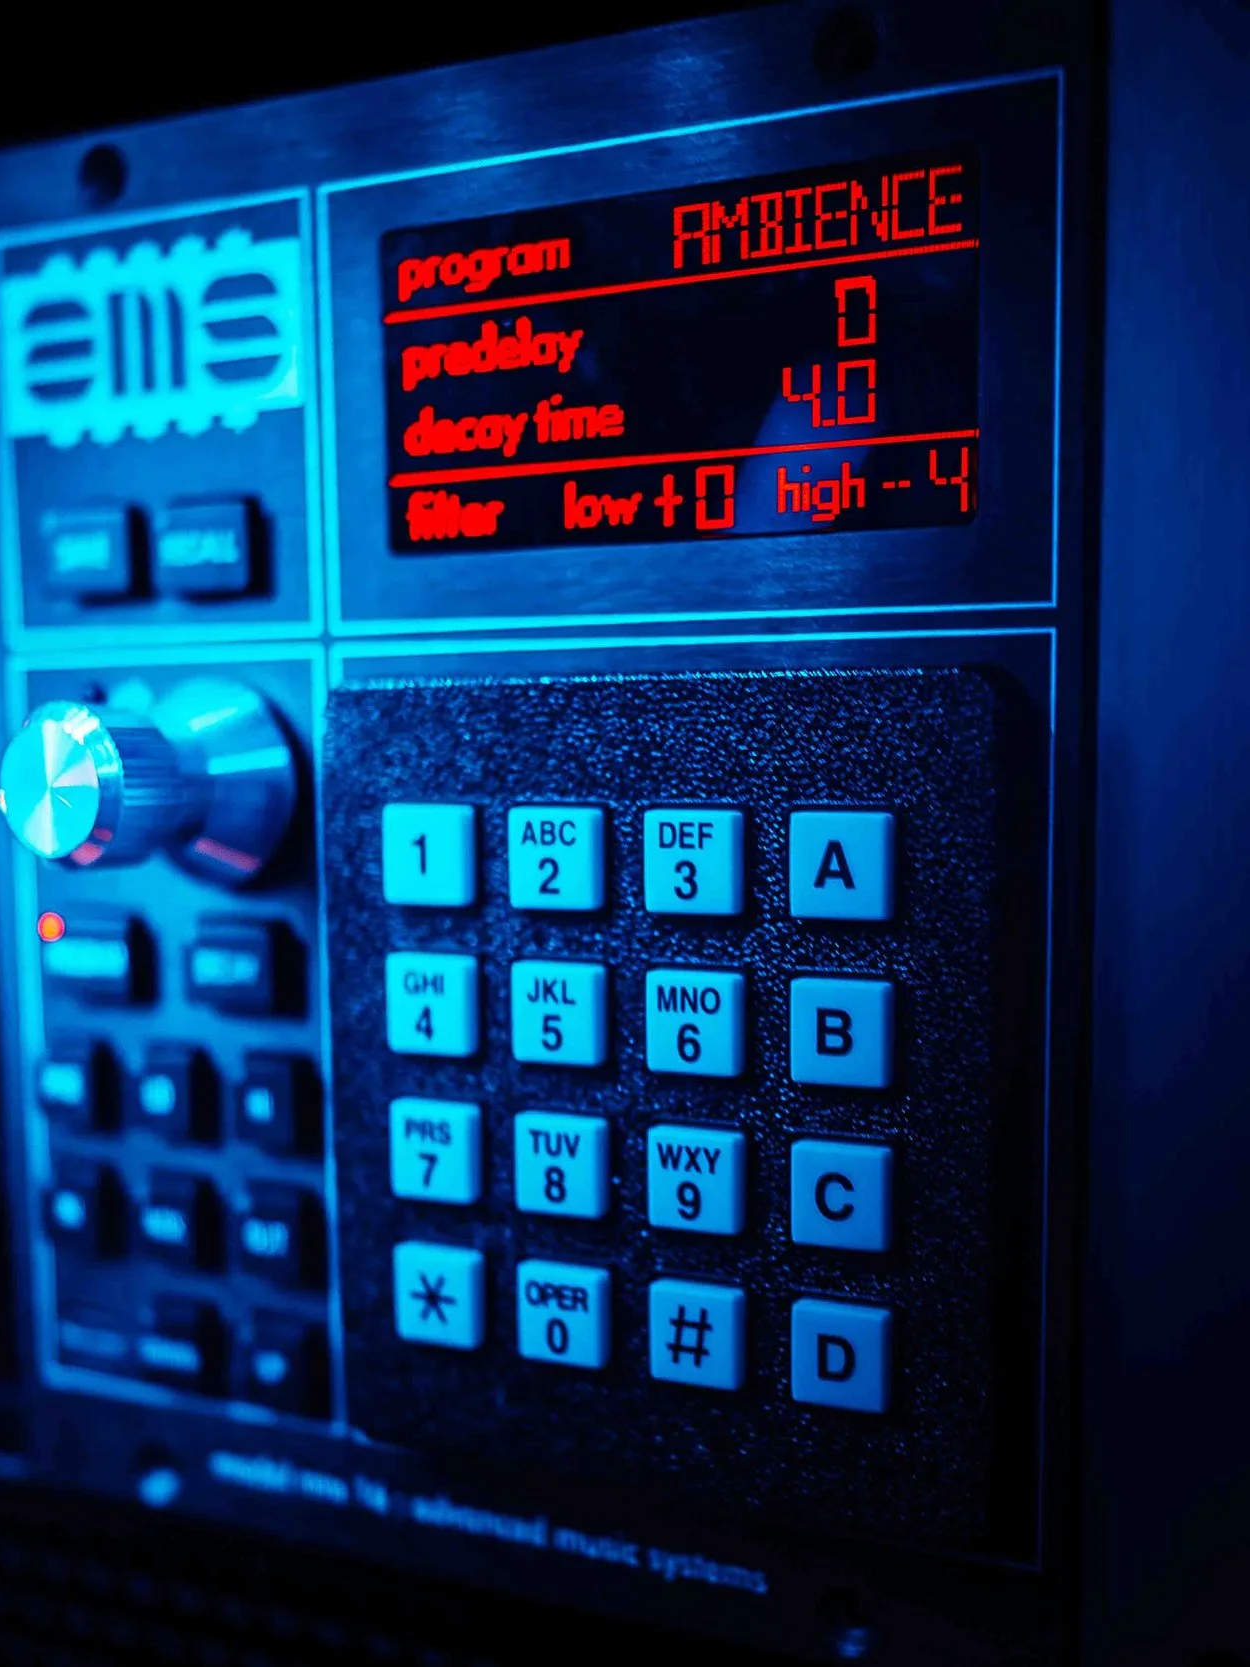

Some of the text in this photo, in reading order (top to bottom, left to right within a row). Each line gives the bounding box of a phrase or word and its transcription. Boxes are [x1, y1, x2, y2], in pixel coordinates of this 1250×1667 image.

[398, 164, 963, 301] program AMBIENCE
[401, 316, 584, 391] predelay
[404, 359, 875, 457] decay time 4.0
[406, 491, 504, 541] filter
[564, 481, 642, 529] low
[778, 463, 864, 521] high
[522, 821, 575, 846] ABC
[659, 822, 713, 849] DEF
[412, 834, 427, 875] 1
[814, 840, 855, 889] A
[539, 858, 560, 894] 2
[674, 860, 698, 900] 3
[404, 973, 444, 994] GHI
[527, 980, 575, 1005] JKL
[657, 986, 721, 1015] MNO
[416, 1007, 433, 1039] 4
[542, 1015, 563, 1051] 5
[817, 1008, 853, 1056] B
[677, 1024, 701, 1063] 6
[405, 1119, 451, 1145] PRS
[529, 1130, 580, 1158] TUV
[420, 1153, 438, 1187] 7
[657, 1143, 721, 1174] WXY
[544, 1166, 566, 1204] 8
[677, 1181, 702, 1221] 9
[815, 1172, 854, 1222] C
[526, 1281, 588, 1312] OPER
[546, 1318, 569, 1355] 0
[817, 1334, 856, 1382] D
